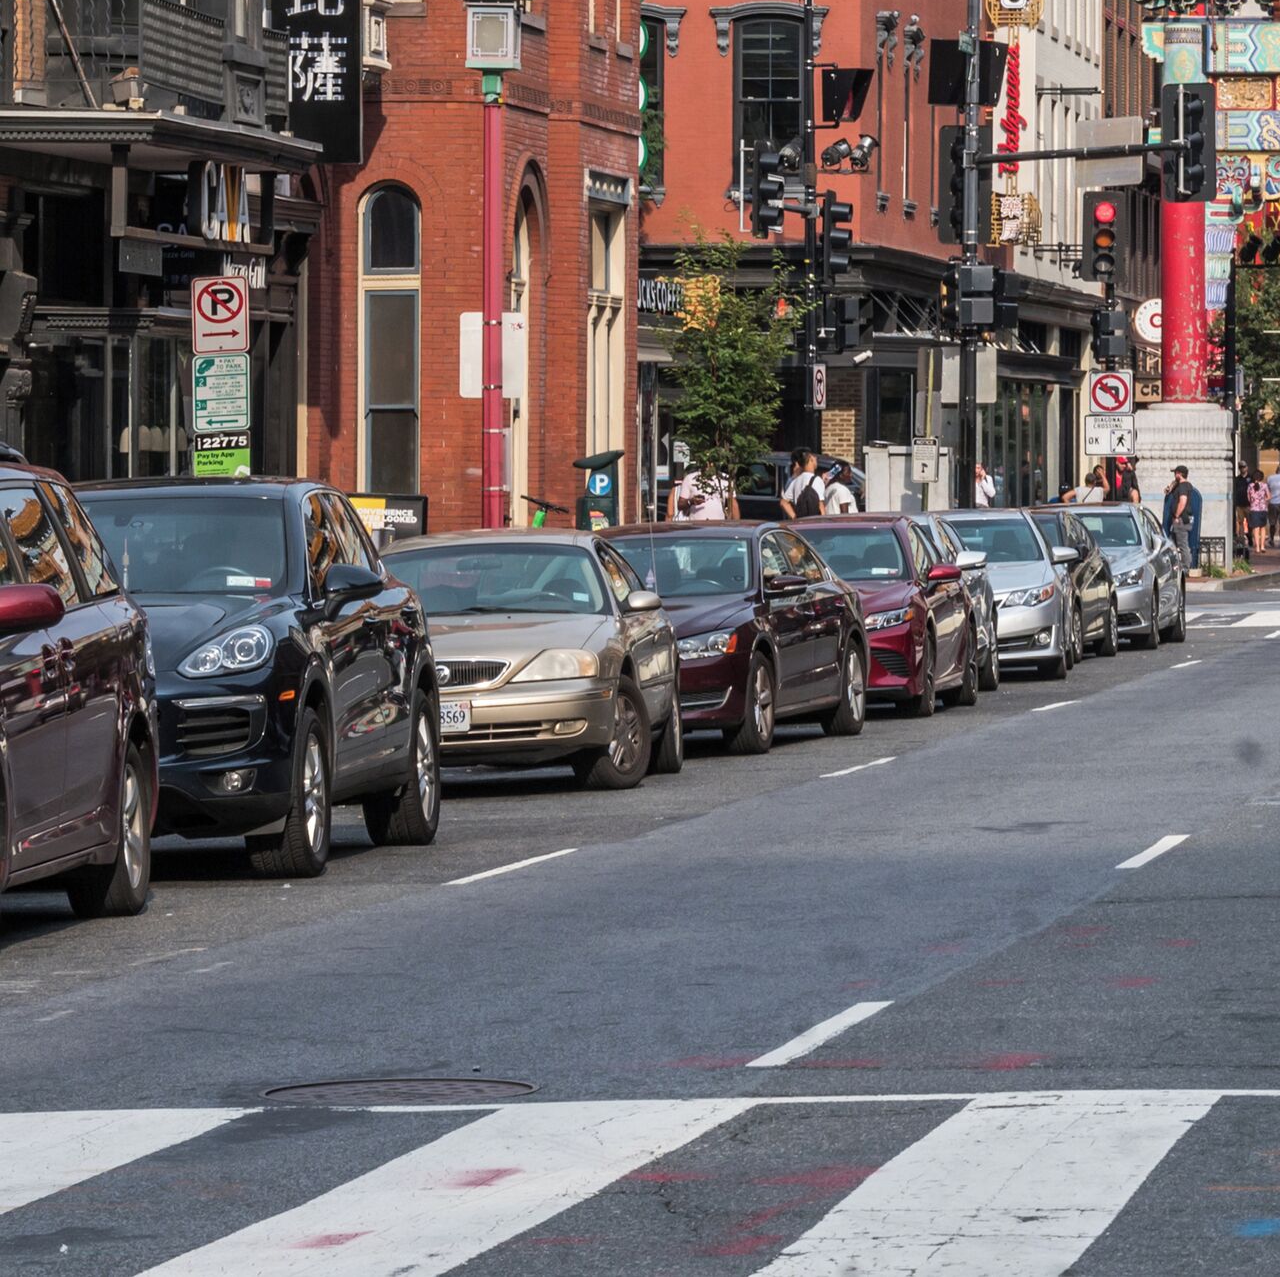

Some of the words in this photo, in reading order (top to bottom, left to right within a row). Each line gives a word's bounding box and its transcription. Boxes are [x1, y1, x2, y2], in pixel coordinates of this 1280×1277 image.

[202, 160, 251, 244] CAVA
[1088, 437, 1100, 445] OK
[595, 474, 609, 494] P
[384, 516, 418, 524] LOOKED
